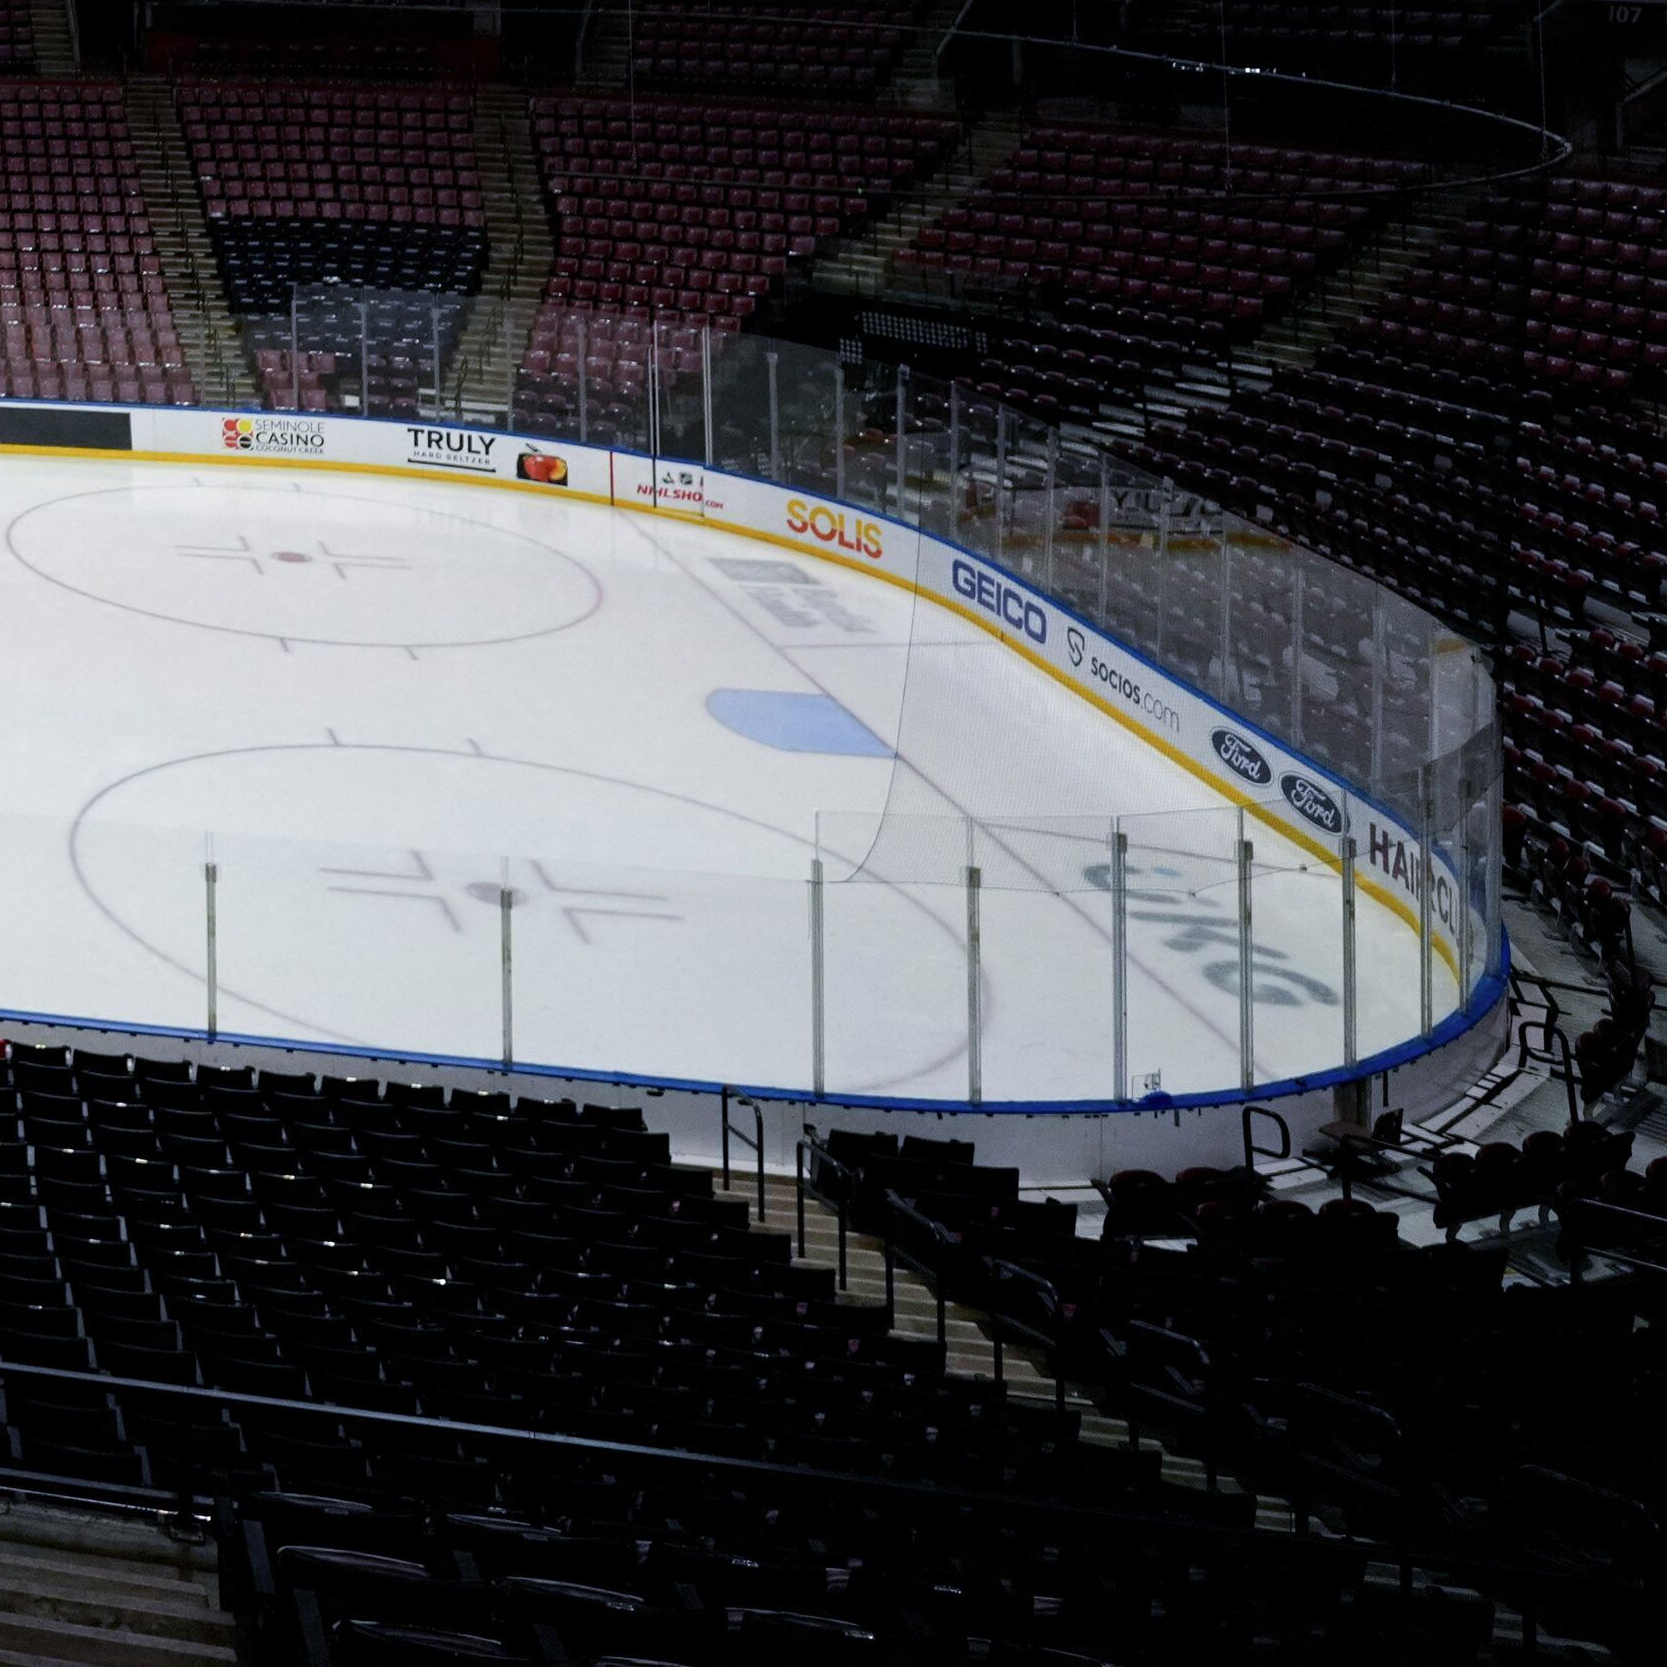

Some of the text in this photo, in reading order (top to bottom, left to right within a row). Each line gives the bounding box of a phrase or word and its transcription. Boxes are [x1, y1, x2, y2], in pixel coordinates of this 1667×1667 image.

[1609, 5, 1643, 24] 107
[255, 419, 325, 433] SEMINOLE
[255, 432, 325, 447] CASINO
[255, 445, 298, 454] COCONUT
[407, 428, 496, 456] TRULY
[413, 450, 491, 465] HARD SELTZER
[786, 498, 883, 560] SOLIS
[952, 558, 1047, 645] GEICO
[1219, 733, 1261, 781] Ford
[1290, 780, 1336, 829] Ford
